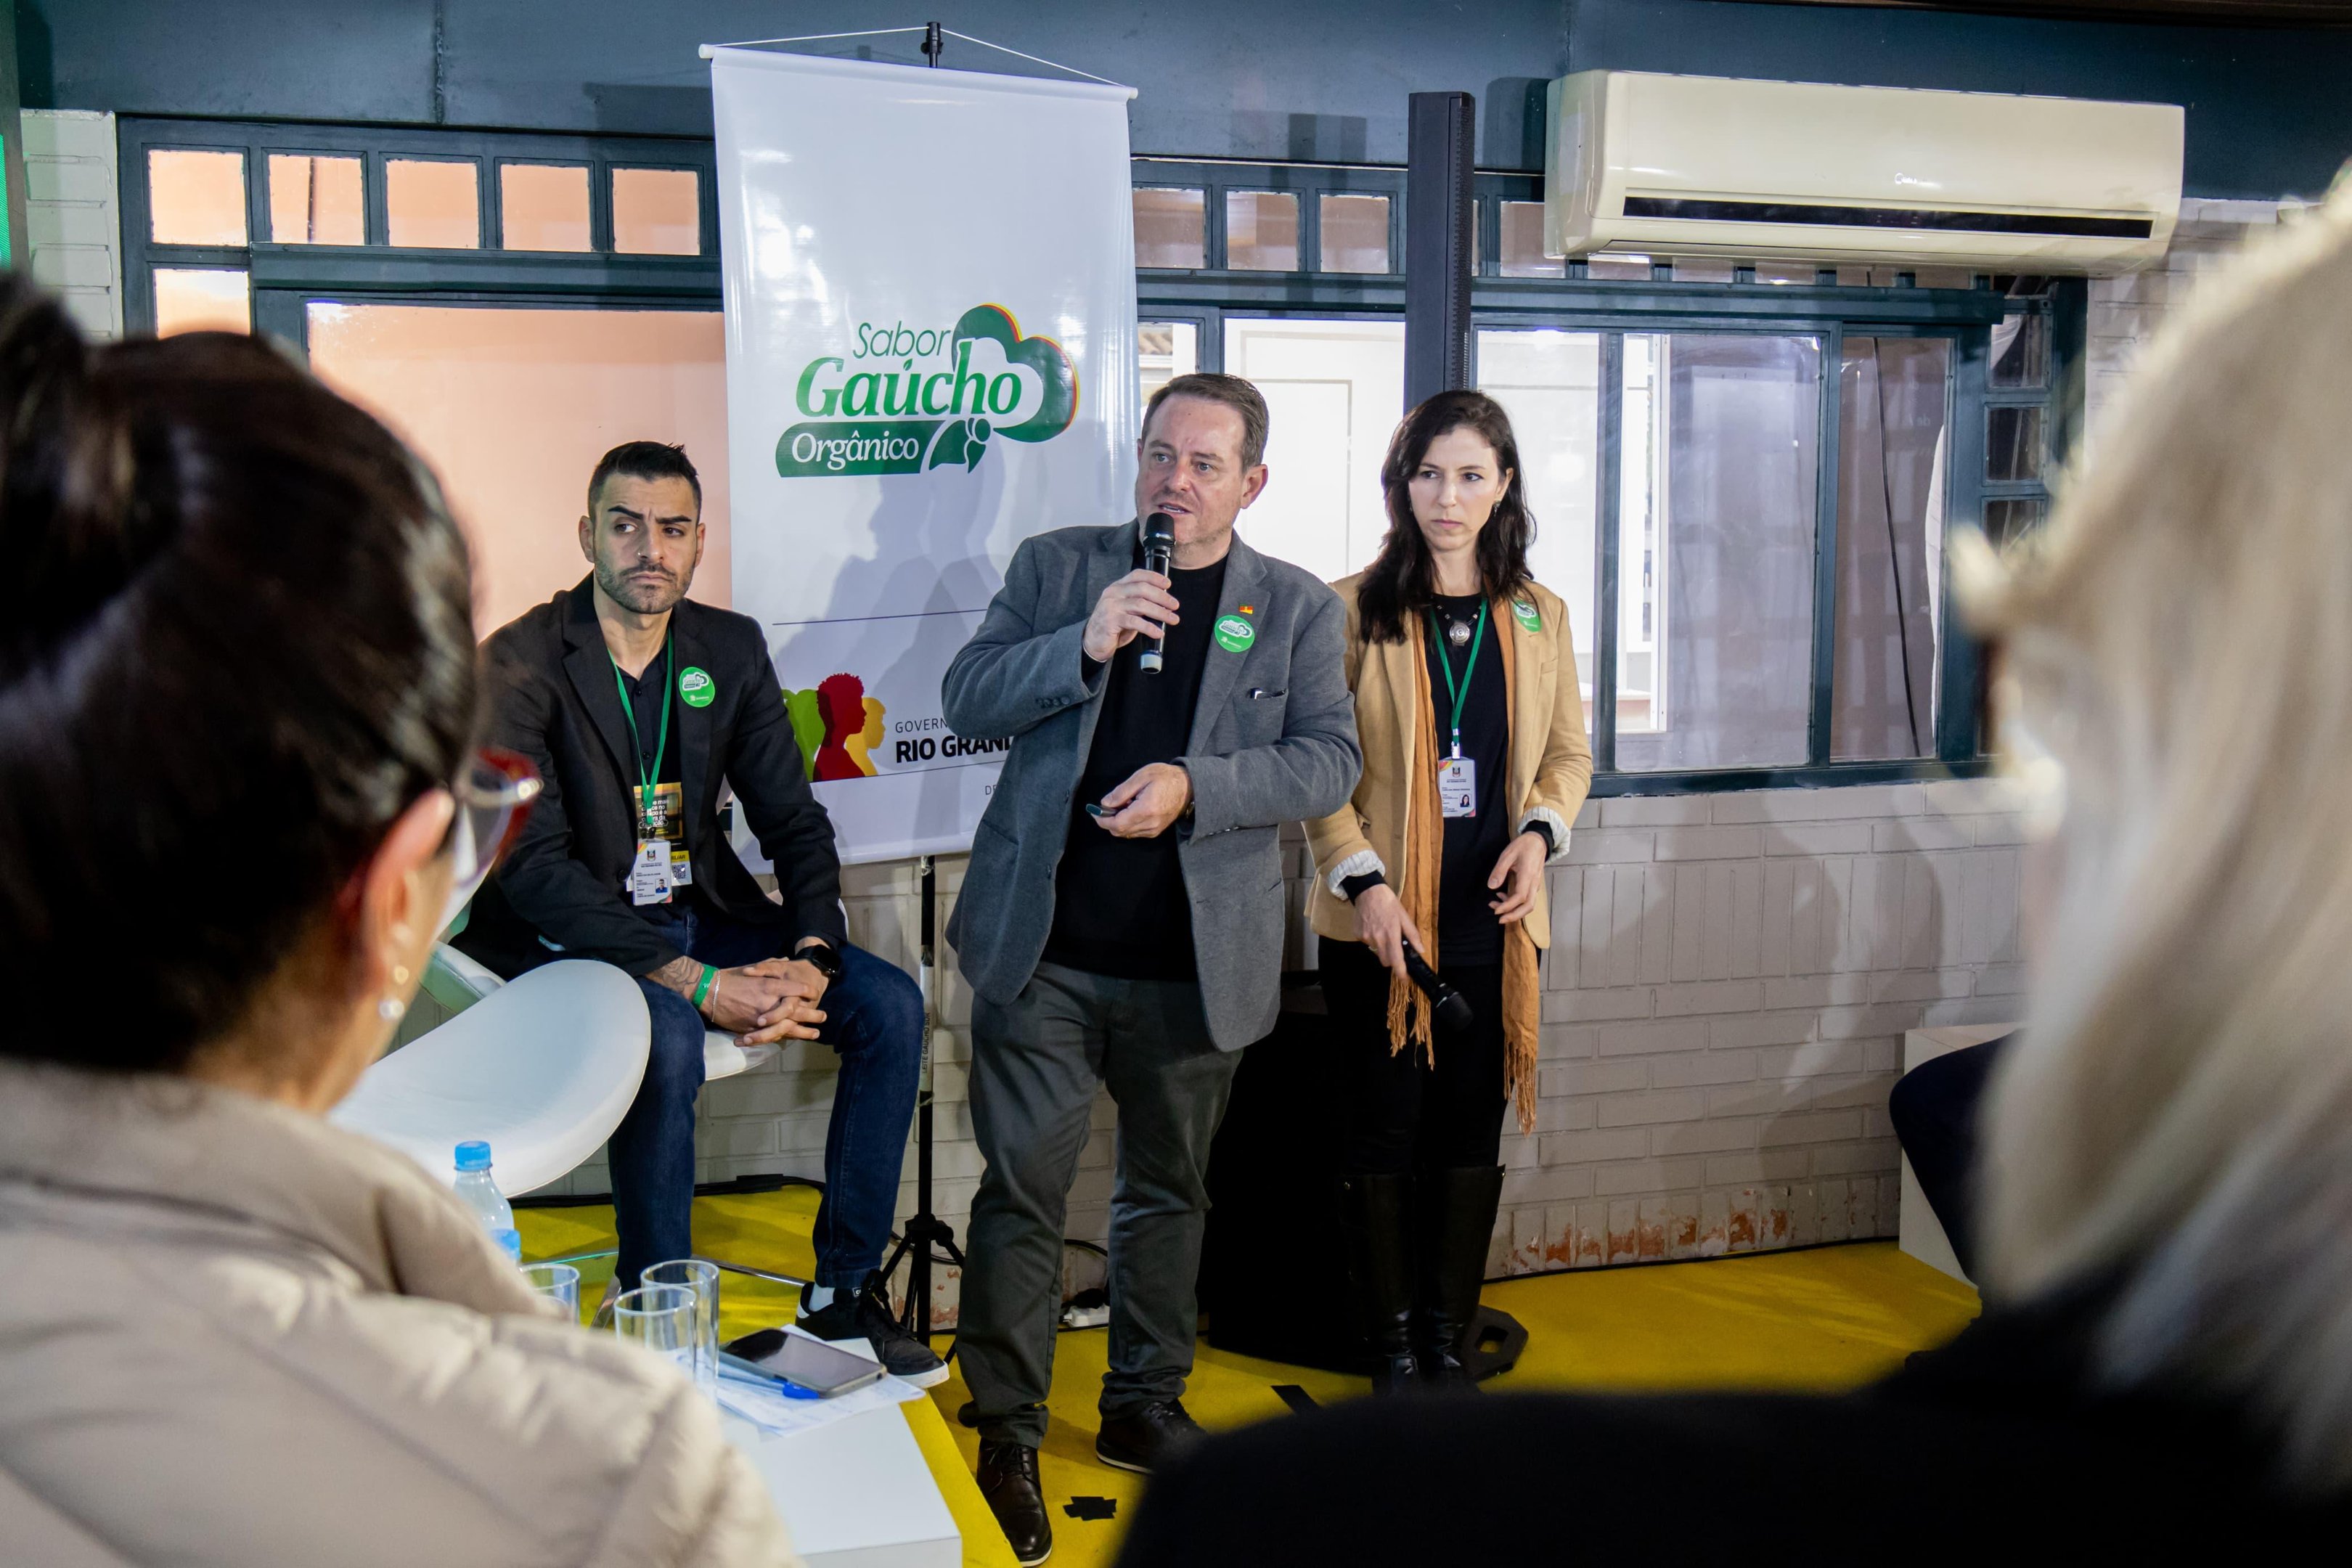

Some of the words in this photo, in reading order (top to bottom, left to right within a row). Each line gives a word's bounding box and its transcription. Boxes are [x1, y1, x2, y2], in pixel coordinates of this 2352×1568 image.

[853, 320, 951, 359] Sabor
[796, 341, 1022, 417] Gaúcho
[791, 430, 920, 470] Orgânico
[896, 738, 936, 764] RIO
